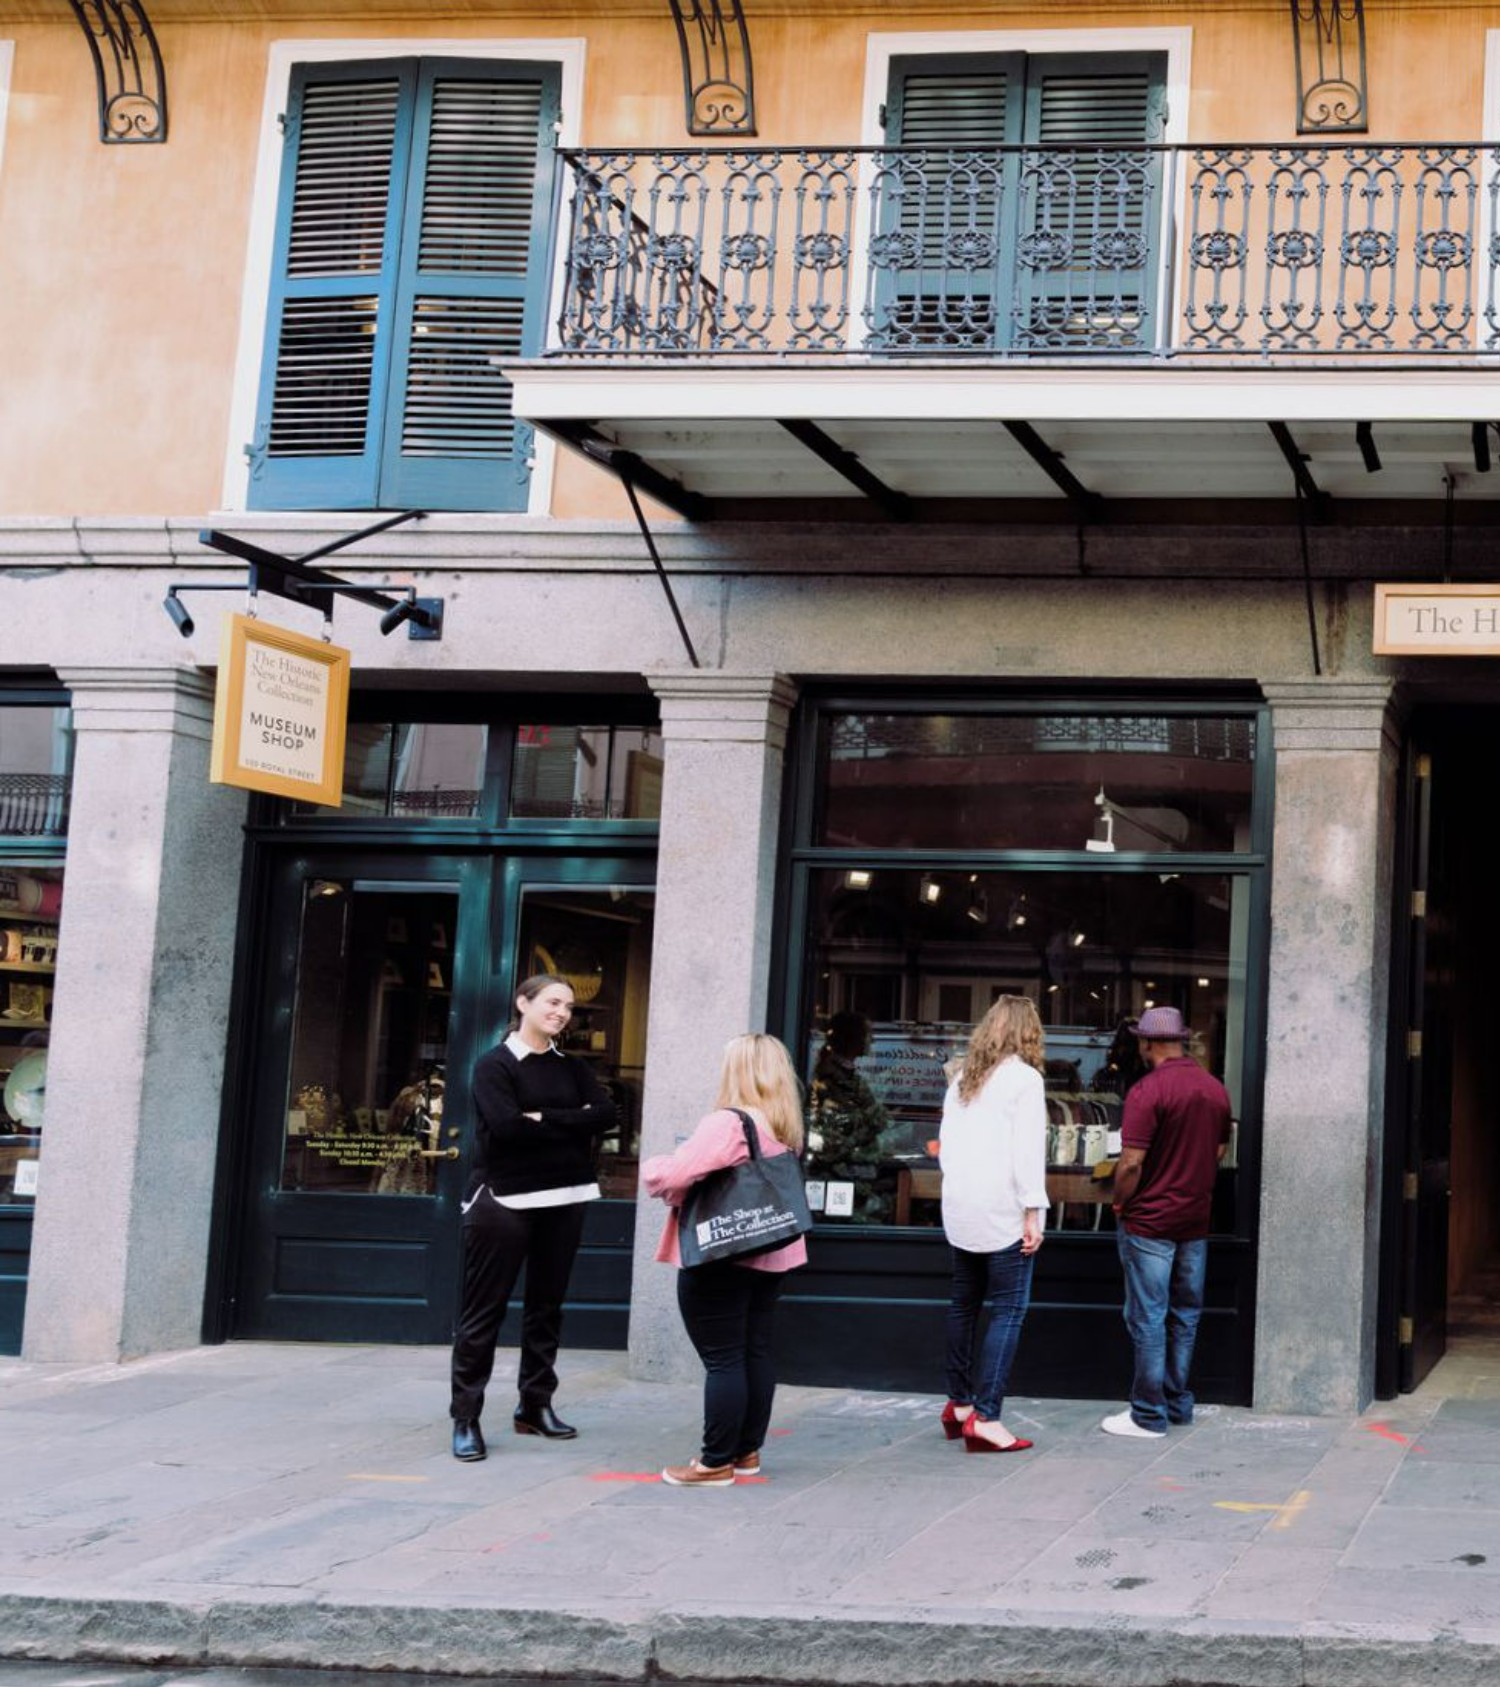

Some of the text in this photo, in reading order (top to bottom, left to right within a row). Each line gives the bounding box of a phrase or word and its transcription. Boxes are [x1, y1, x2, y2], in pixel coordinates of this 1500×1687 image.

[1407, 607, 1463, 635] The
[252, 664, 321, 695] New Orleans
[253, 650, 322, 681] The Historic
[257, 681, 314, 707] Collection
[250, 712, 317, 740] MUSEUM
[262, 731, 304, 751] SHOP
[710, 1214, 732, 1228] The
[733, 1208, 762, 1223] Shop
[711, 1211, 795, 1240] The Collection
